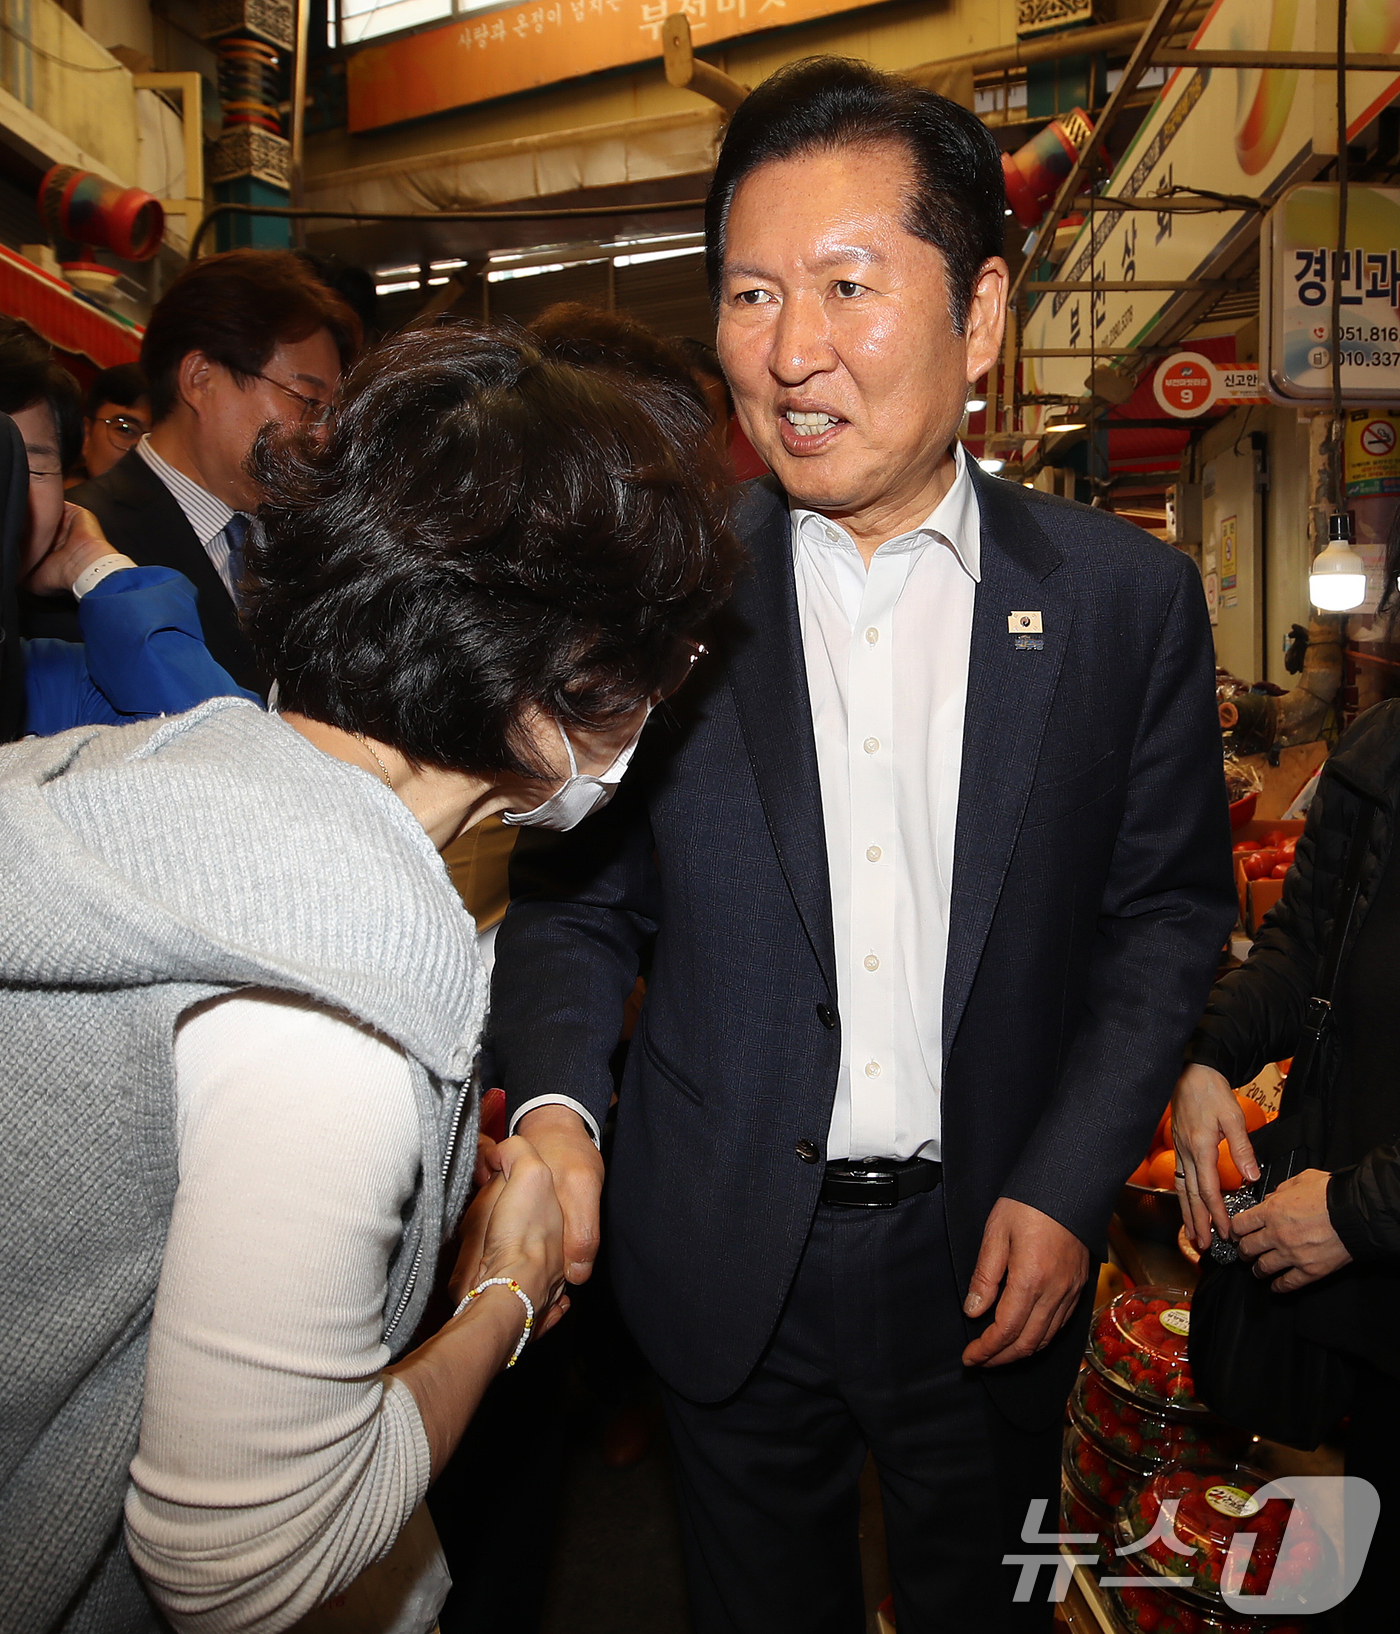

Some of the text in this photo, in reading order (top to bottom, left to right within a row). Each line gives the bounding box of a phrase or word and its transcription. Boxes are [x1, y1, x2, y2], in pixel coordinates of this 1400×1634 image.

[457, 18, 507, 50] 사랑과
[512, 2, 562, 38] 온정이
[1294, 248, 1400, 306] 경민과
[1181, 389, 1193, 403] 9
